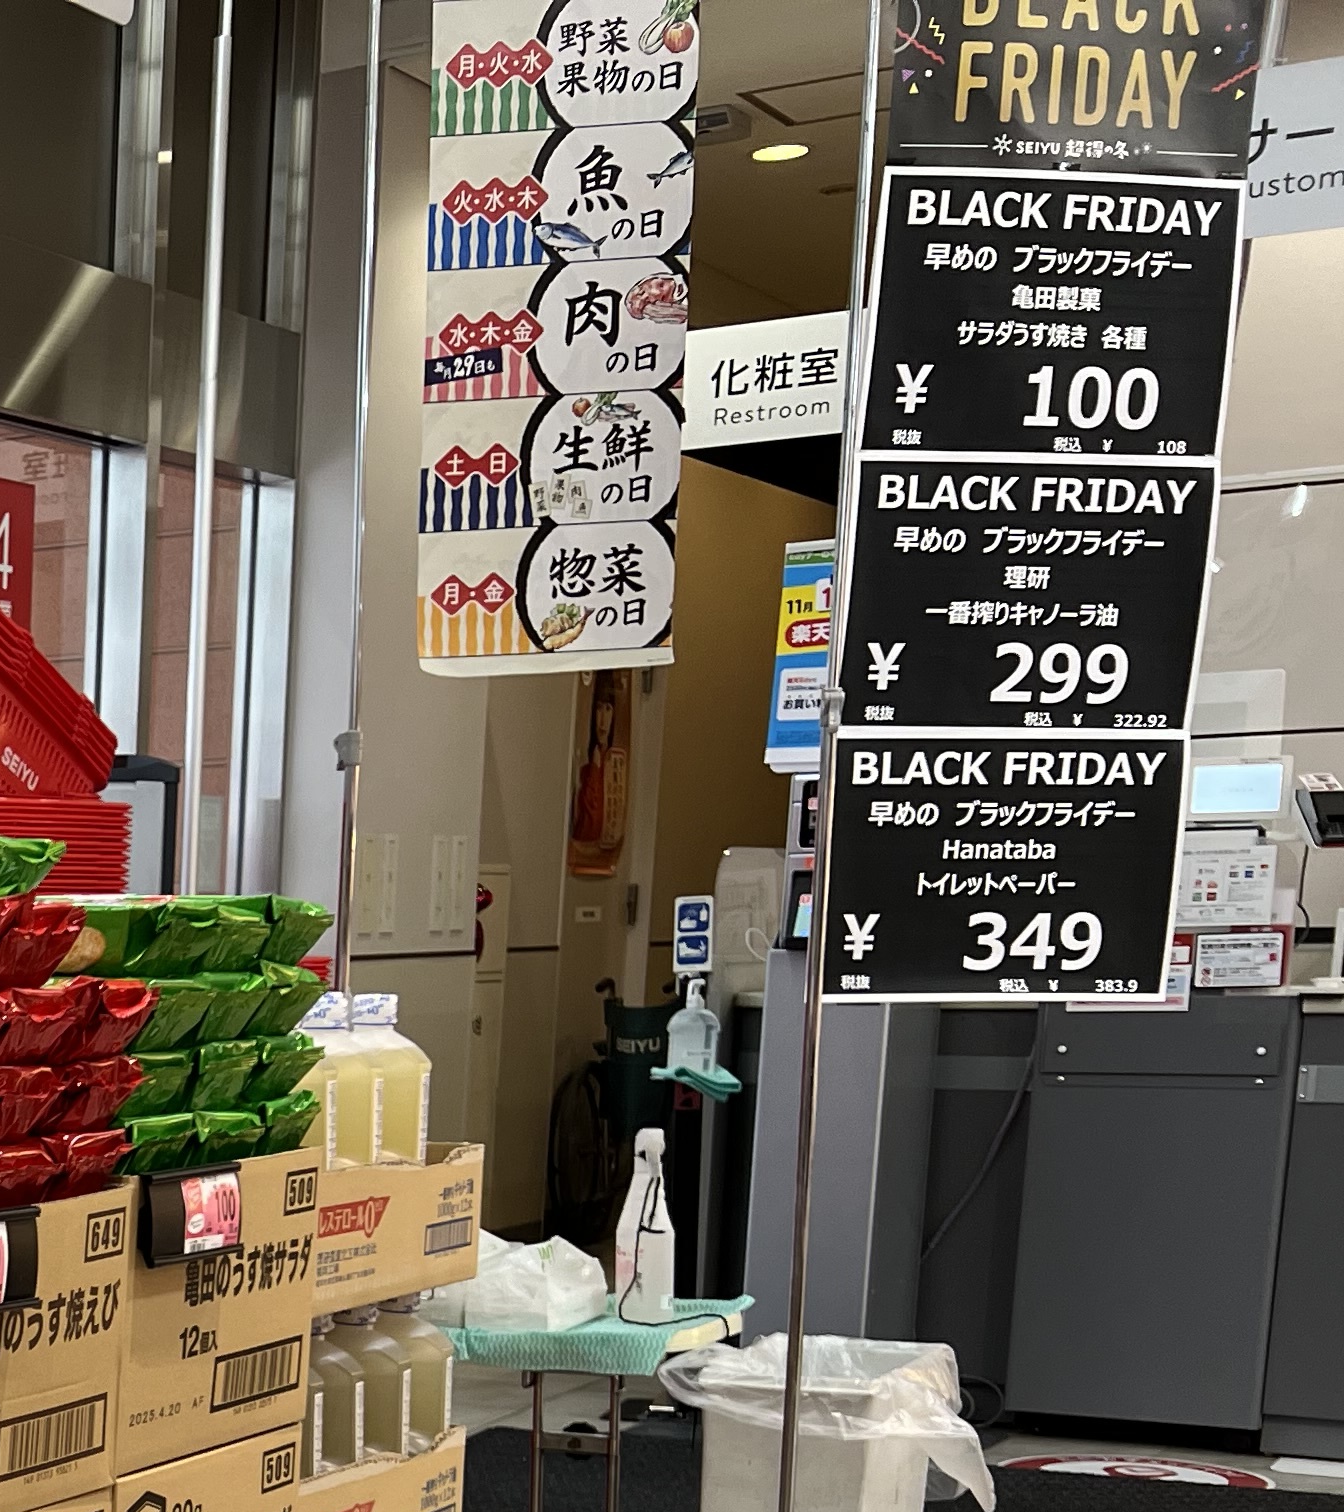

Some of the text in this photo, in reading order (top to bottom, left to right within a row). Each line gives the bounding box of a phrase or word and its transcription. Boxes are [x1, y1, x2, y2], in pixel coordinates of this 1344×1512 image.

[558, 17, 630, 55] 野菜
[557, 60, 683, 98] 果物の日
[954, 38, 1197, 130] FRIDAY
[1016, 140, 1061, 156] SEIYU
[567, 145, 628, 217] 魚
[612, 209, 665, 240] の日
[907, 189, 1222, 237] BLACK FRIDAY
[923, 243, 1193, 279] 早めの ブラックフライデー
[565, 281, 623, 346] 肉
[1011, 284, 1102, 313] 亀田製菓
[958, 321, 1148, 351] サラダうす焼き 各種
[606, 344, 659, 373] の日
[711, 348, 839, 399] 化粧室
[714, 400, 830, 426] Restroom
[1023, 365, 1159, 430] 100
[444, 452, 507, 477] 土 日
[552, 420, 654, 475] 生鮮
[1157, 440, 1186, 455] 108
[601, 475, 652, 505] の日
[877, 474, 1196, 515] BLACK FRIDAY
[894, 527, 1165, 557] 早めの ブラックフライデー
[550, 544, 646, 599] 惣菜
[1004, 566, 1050, 590] 理研
[595, 598, 646, 627] の日
[925, 601, 1119, 628] 一番搾りキャノーラ油
[989, 642, 1129, 705] 299
[1113, 714, 1167, 728] 322.92
[0, 745, 39, 791] SEIYU
[852, 751, 1166, 786] BLACK FRIDAY
[868, 800, 1135, 828] 早めの ブラックフライデー
[942, 839, 1056, 860] Hanataba
[917, 872, 1076, 897] トイレットペーパー
[962, 911, 1103, 972] 349
[1095, 979, 1138, 994] 383.9
[615, 1035, 662, 1055] SEIYU
[214, 1187, 239, 1223] 100
[287, 1173, 315, 1212] 509
[90, 1216, 120, 1256] 649
[179, 1325, 219, 1361] 12個入
[128, 1401, 182, 1428] 2025.4.20
[266, 1447, 291, 1487] 509
